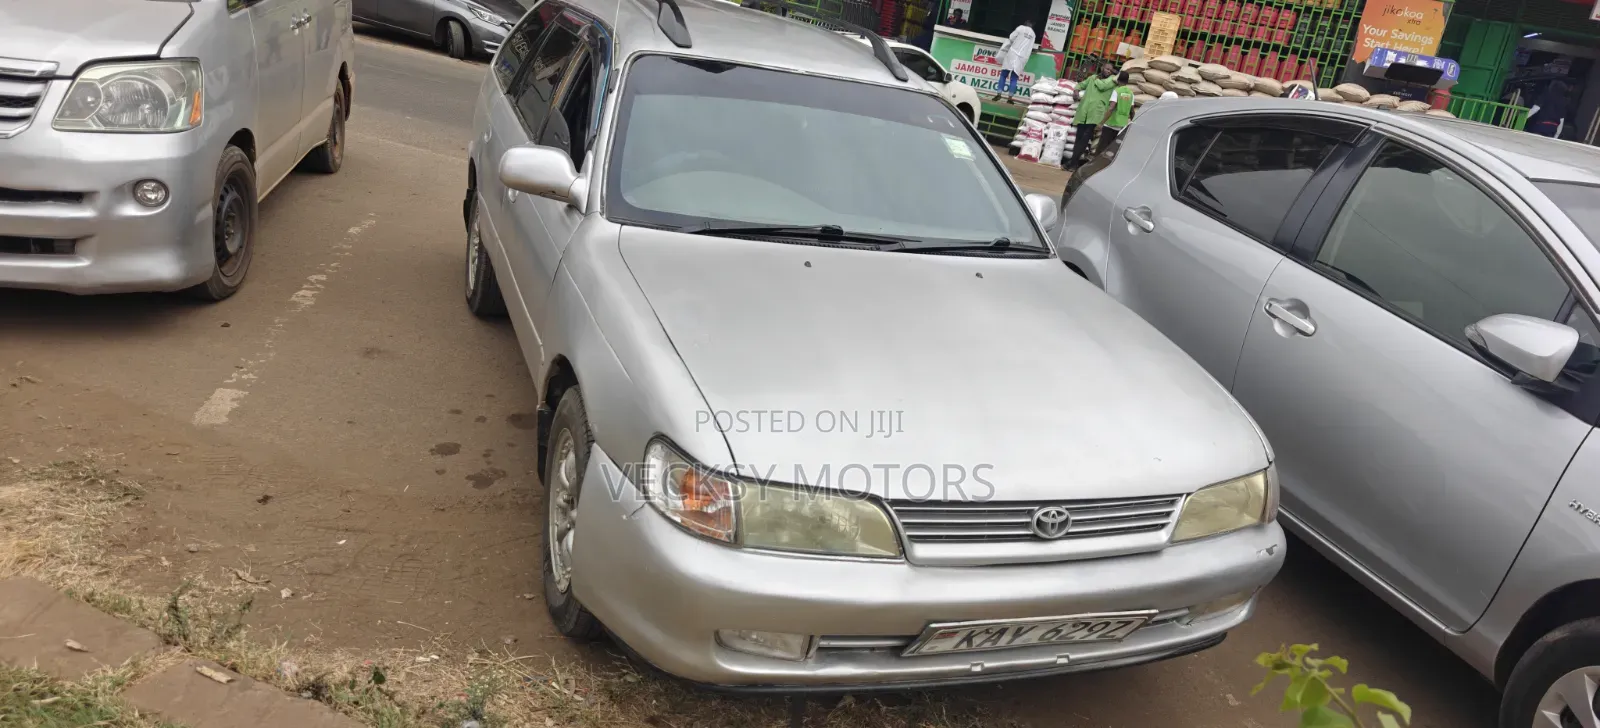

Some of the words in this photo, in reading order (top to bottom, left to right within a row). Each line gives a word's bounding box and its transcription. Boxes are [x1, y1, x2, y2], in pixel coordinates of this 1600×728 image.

[1363, 24, 1388, 38] Your
[1390, 28, 1434, 46] Savings
[1363, 37, 1391, 49] Start
[1393, 42, 1425, 54] Here!
[977, 48, 998, 57] powe
[955, 62, 988, 75] JAMBO
[990, 70, 1031, 83] BRCH
[953, 625, 1037, 649] KAY
[1038, 619, 1133, 642] 629Z
